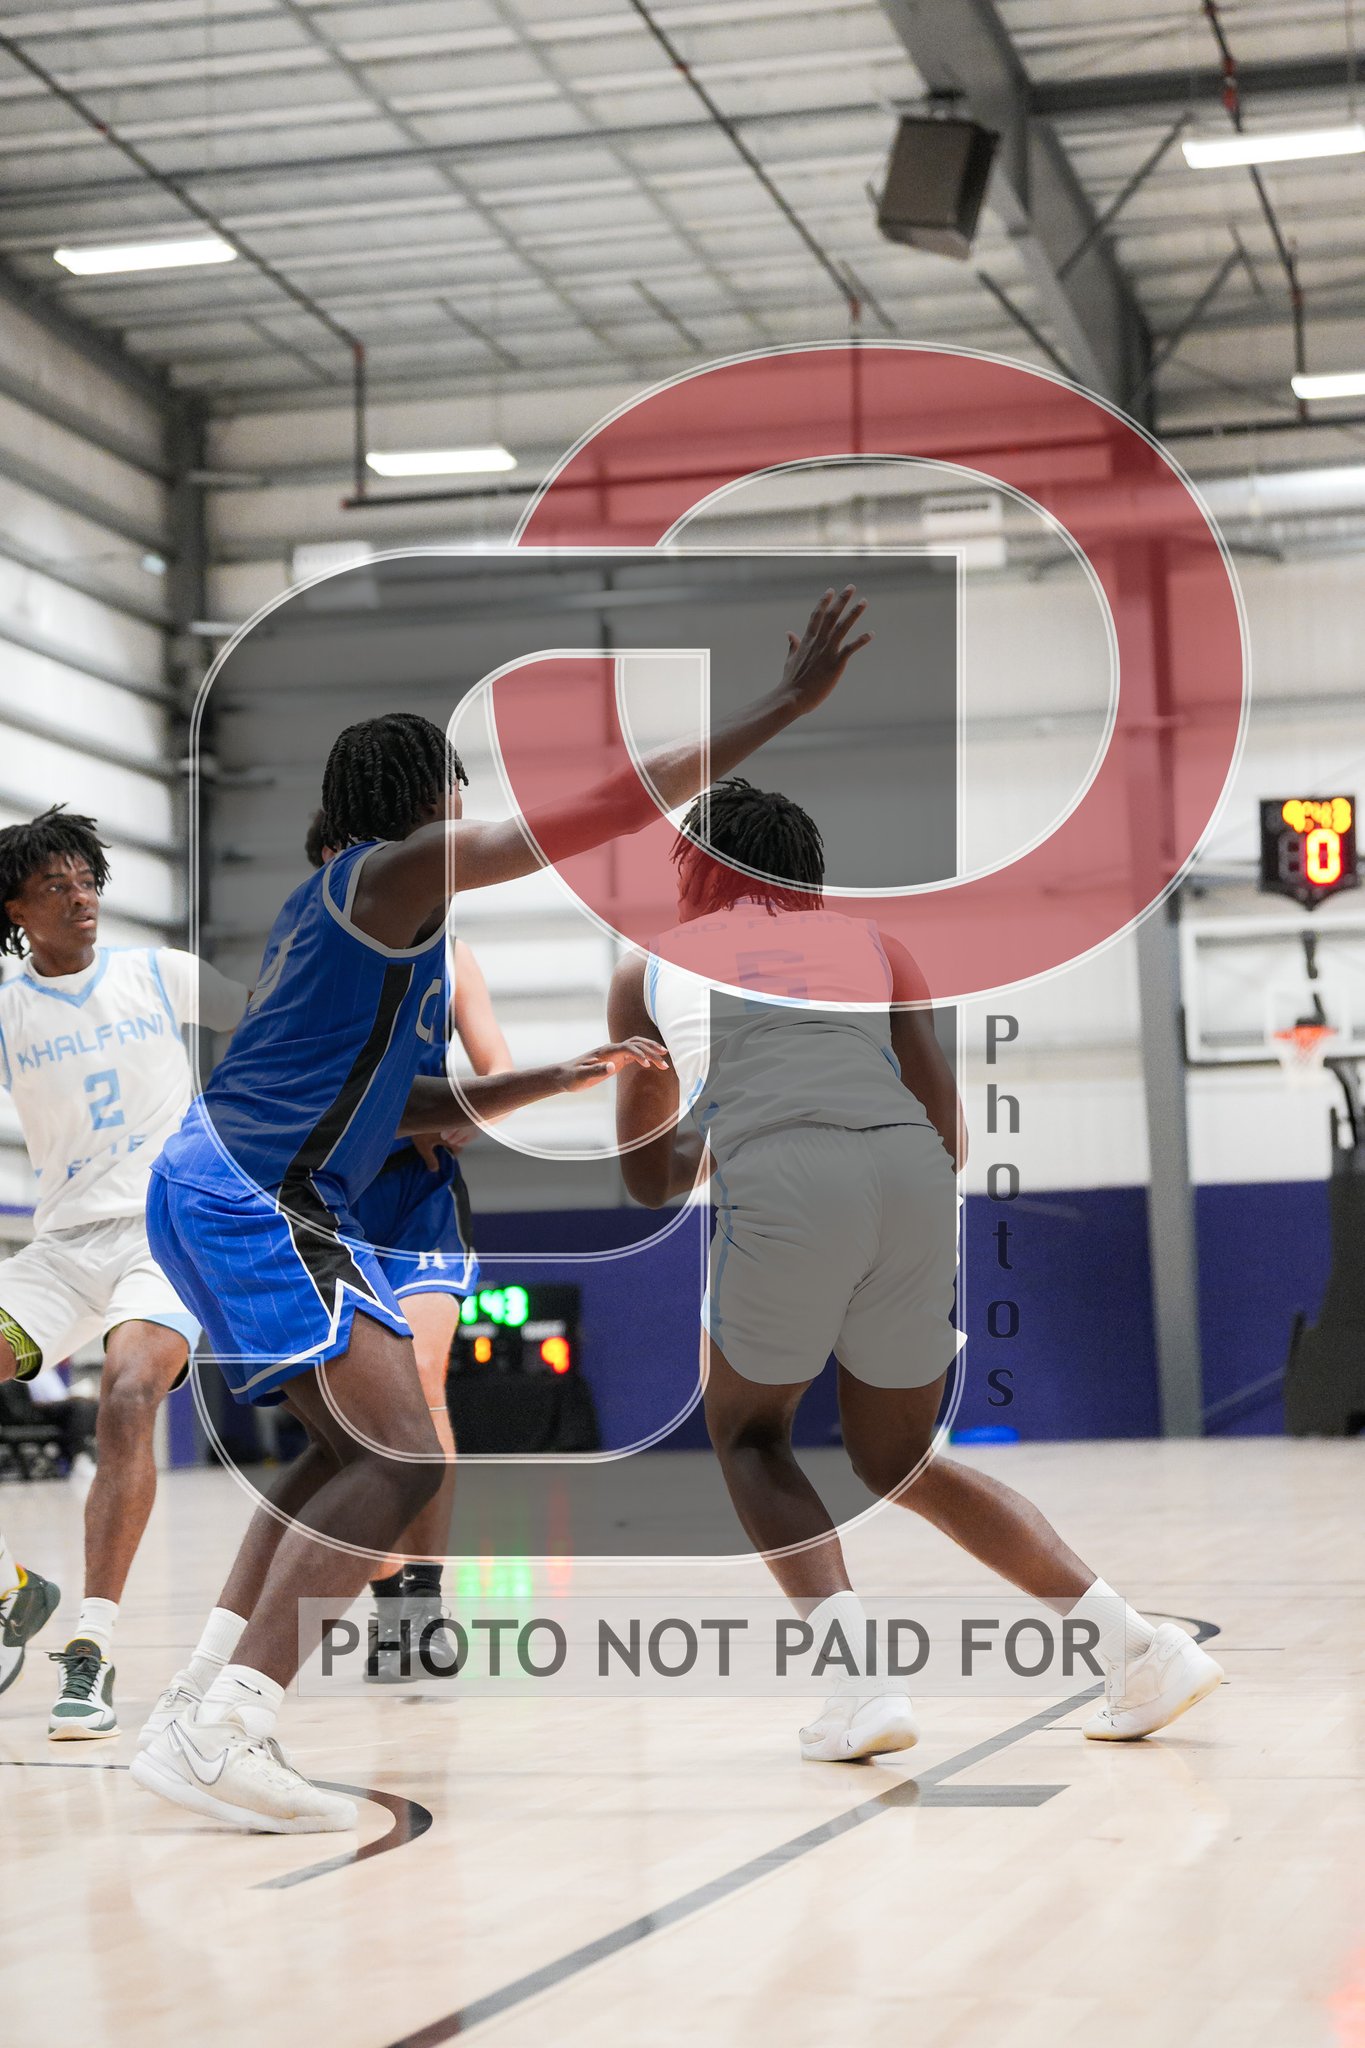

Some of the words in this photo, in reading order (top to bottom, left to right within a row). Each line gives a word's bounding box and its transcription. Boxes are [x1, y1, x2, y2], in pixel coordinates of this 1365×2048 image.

[1305, 827, 1343, 885] 0
[16, 1013, 165, 1073] KHALFANI
[83, 1068, 126, 1132] 2
